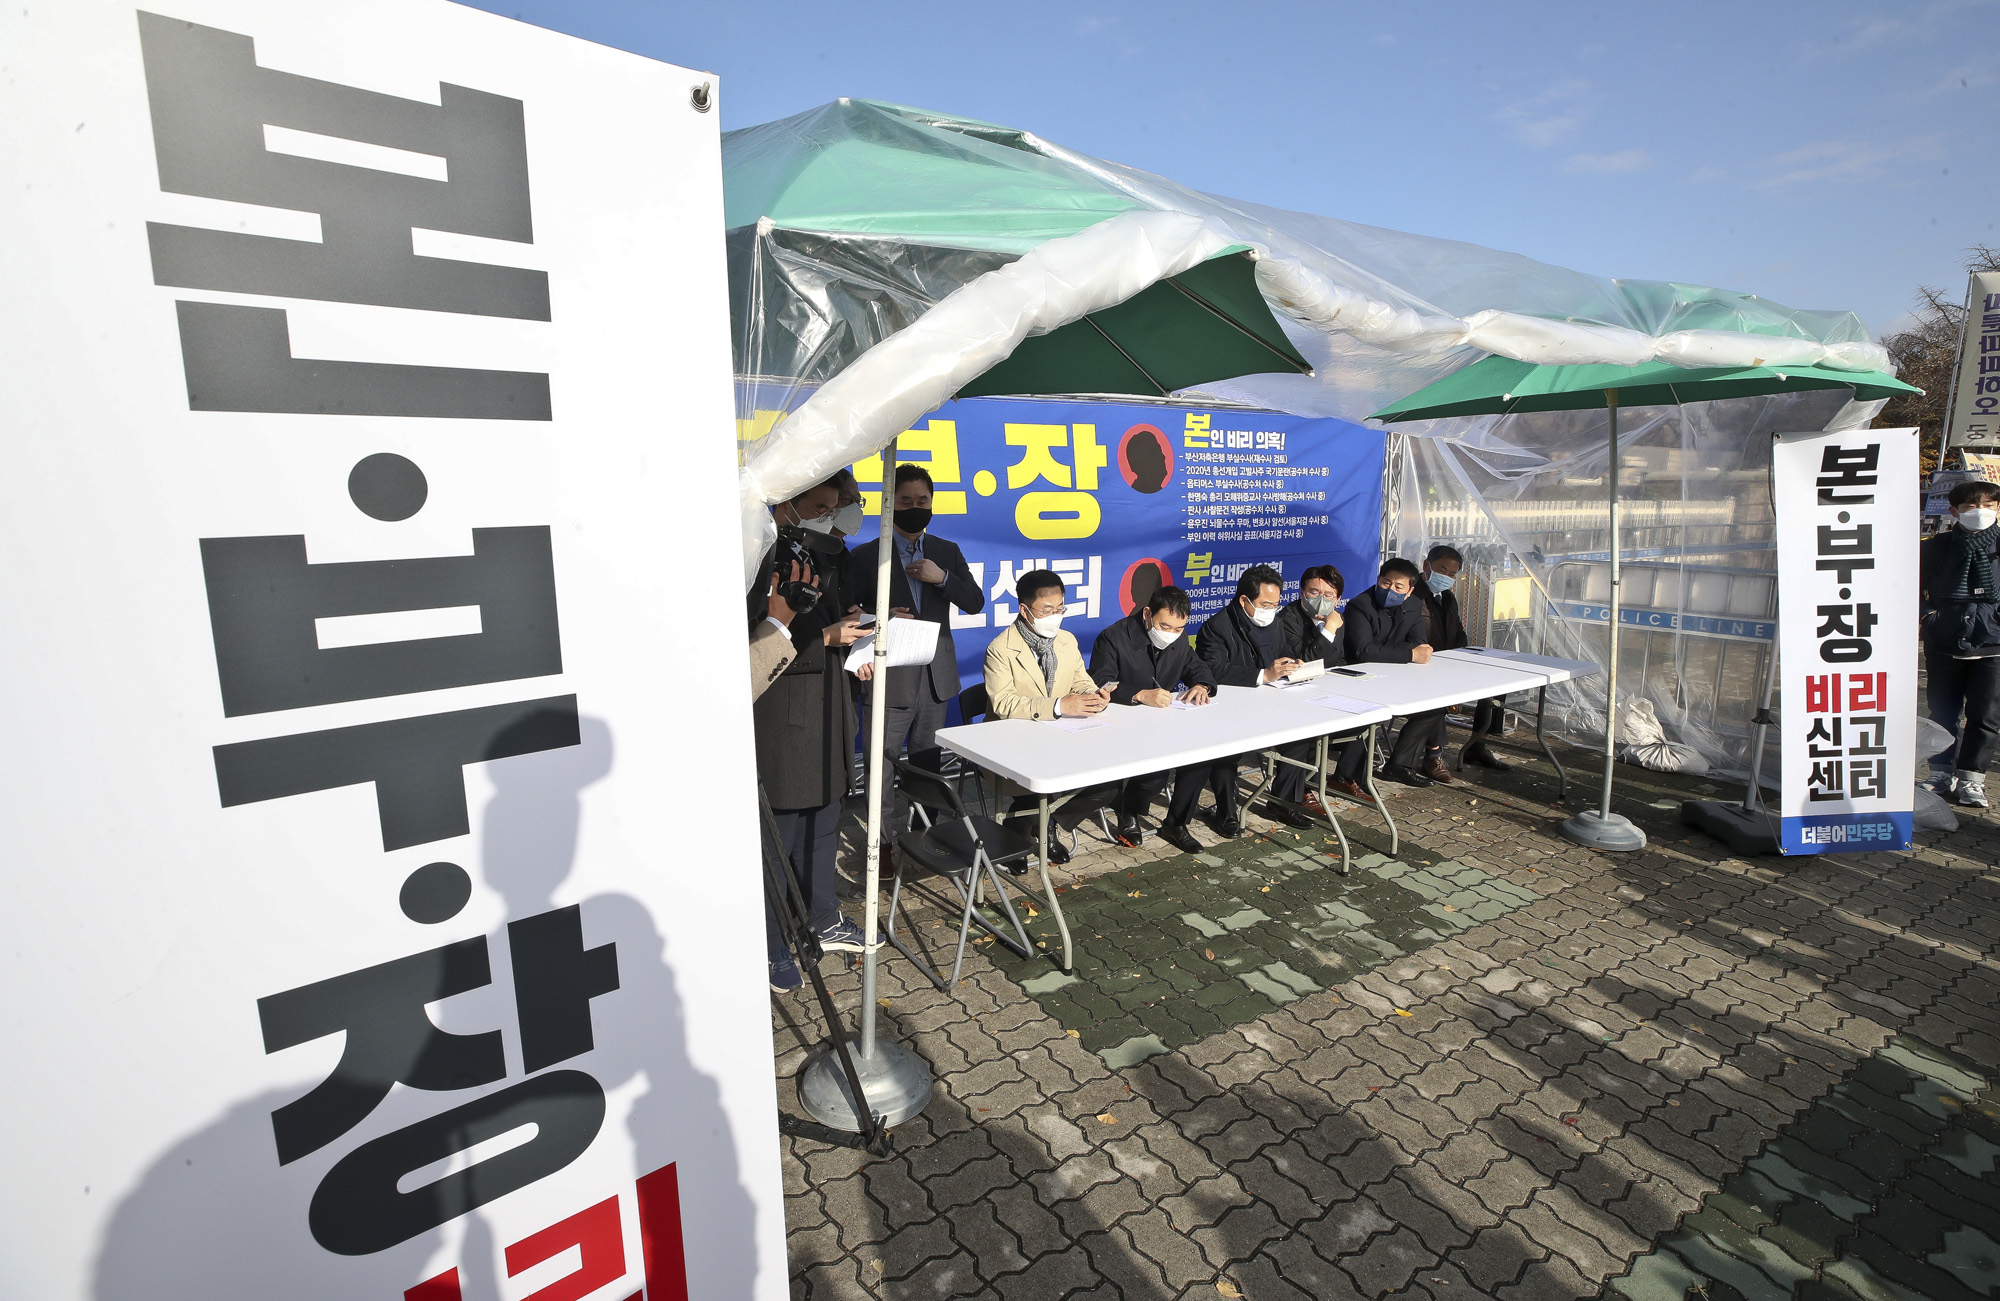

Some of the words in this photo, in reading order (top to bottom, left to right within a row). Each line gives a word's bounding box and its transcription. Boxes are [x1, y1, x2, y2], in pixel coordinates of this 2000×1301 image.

[1227, 430, 1253, 449] 비리
[1256, 431, 1286, 450] 의혹!
[1185, 452, 1225, 462] 부산저축은행
[1227, 454, 1272, 464] 부실수사(재수사
[1274, 454, 1288, 464] 검토)
[1186, 466, 1211, 475] 2020년
[1212, 466, 1238, 476] 총선개입
[1240, 466, 1264, 476] 고발사주
[1309, 467, 1320, 476] 수사
[1321, 467, 1330, 476] 중)
[1187, 479, 1214, 488] 옵티머스
[1215, 479, 1261, 489] 부실수사(공수처
[1262, 480, 1275, 489] 수사
[1276, 480, 1284, 489] 중)
[1187, 492, 1208, 502] 한명숙
[1209, 492, 1222, 502] 총리
[1306, 492, 1317, 501] 수사
[1318, 491, 1326, 501] 중)
[1188, 506, 1201, 515] 판사
[1203, 505, 1229, 515] 사찰문건
[1231, 505, 1264, 515] 작성(공수처
[1265, 505, 1277, 514] 수사
[1278, 504, 1286, 514] 중)
[1187, 519, 1208, 528] 윤우진
[1210, 518, 1235, 528] 뇌물수수
[1253, 518, 1270, 527] 변호사
[1272, 516, 1307, 526] 알선(서울지검
[1308, 516, 1320, 525] 수사
[1321, 515, 1328, 524] 중)
[1187, 532, 1201, 542] 부인
[1202, 532, 1216, 541] 이력
[1218, 531, 1243, 541] 허위사실
[1244, 530, 1282, 540] 공표(서울지검
[1283, 529, 1294, 538] 수사
[1296, 529, 1303, 538] 중)
[1184, 552, 1224, 585] 부인
[1190, 600, 1223, 611] 바나컨텐츠
[1583, 608, 1678, 628] POLICE
[1700, 616, 1764, 636] LINE
[1801, 822, 1894, 844] 더불어민주당
